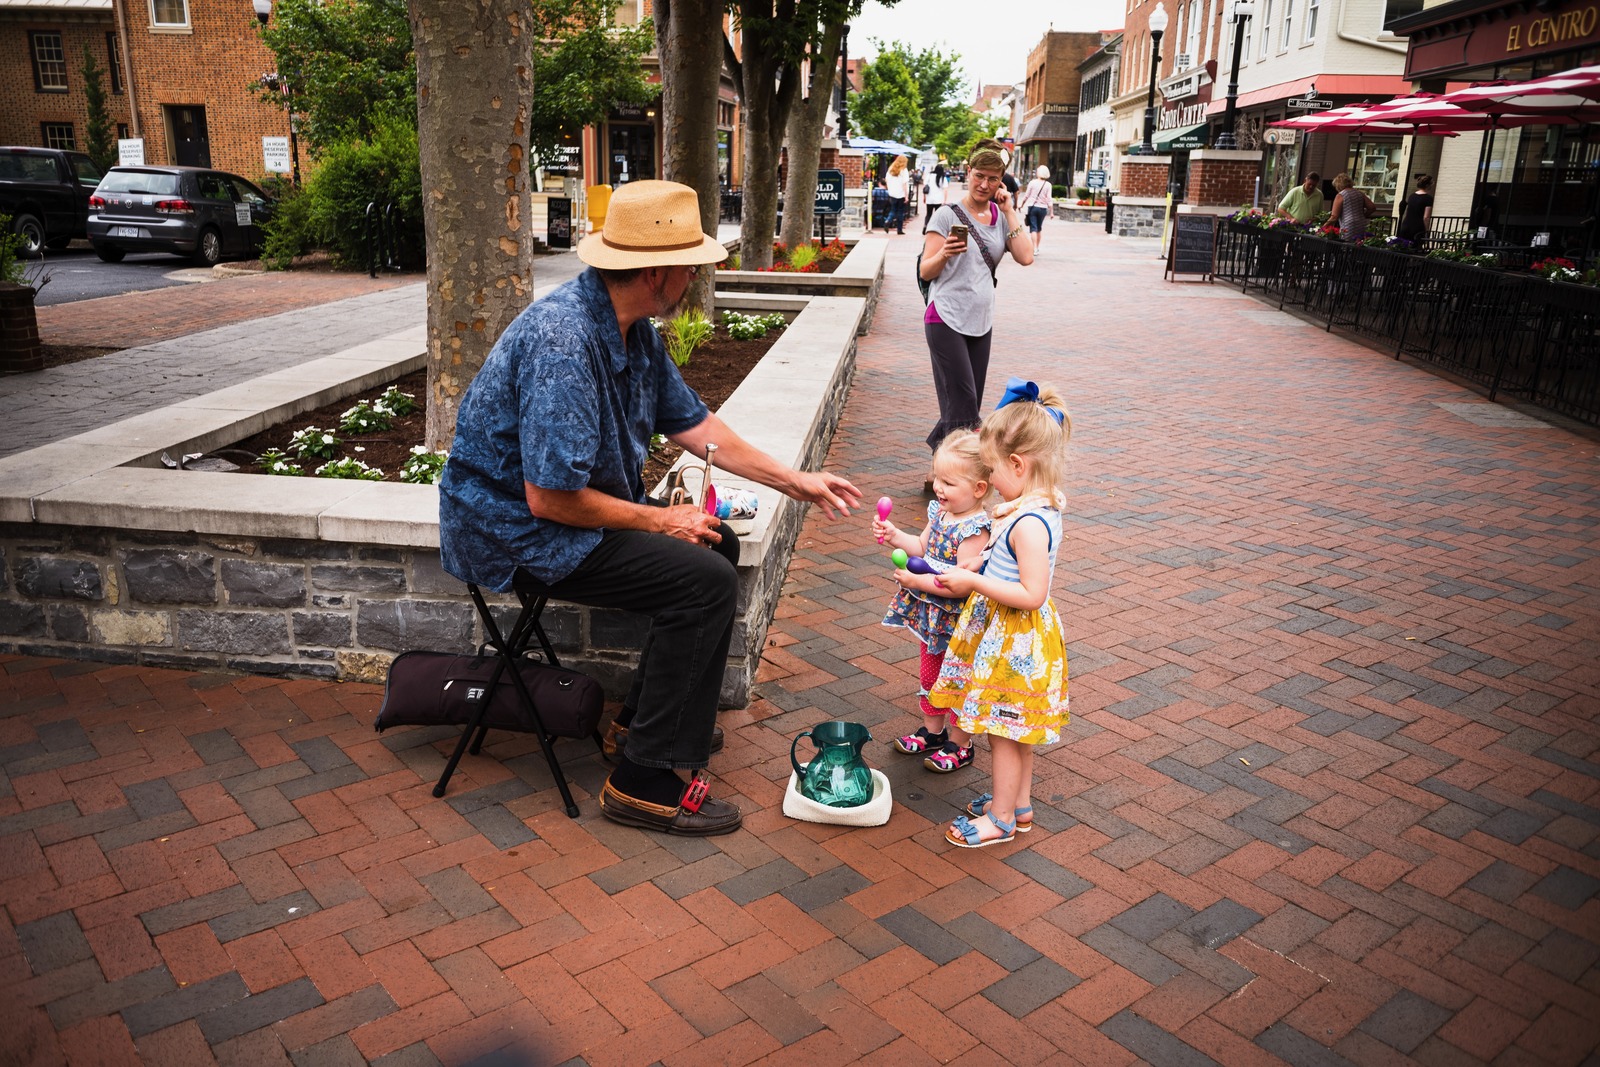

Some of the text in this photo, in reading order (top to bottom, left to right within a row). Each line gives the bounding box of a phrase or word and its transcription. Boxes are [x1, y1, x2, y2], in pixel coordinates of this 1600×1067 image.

[1506, 6, 1597, 51] EL CENTRO
[815, 192, 839, 201] OWN
